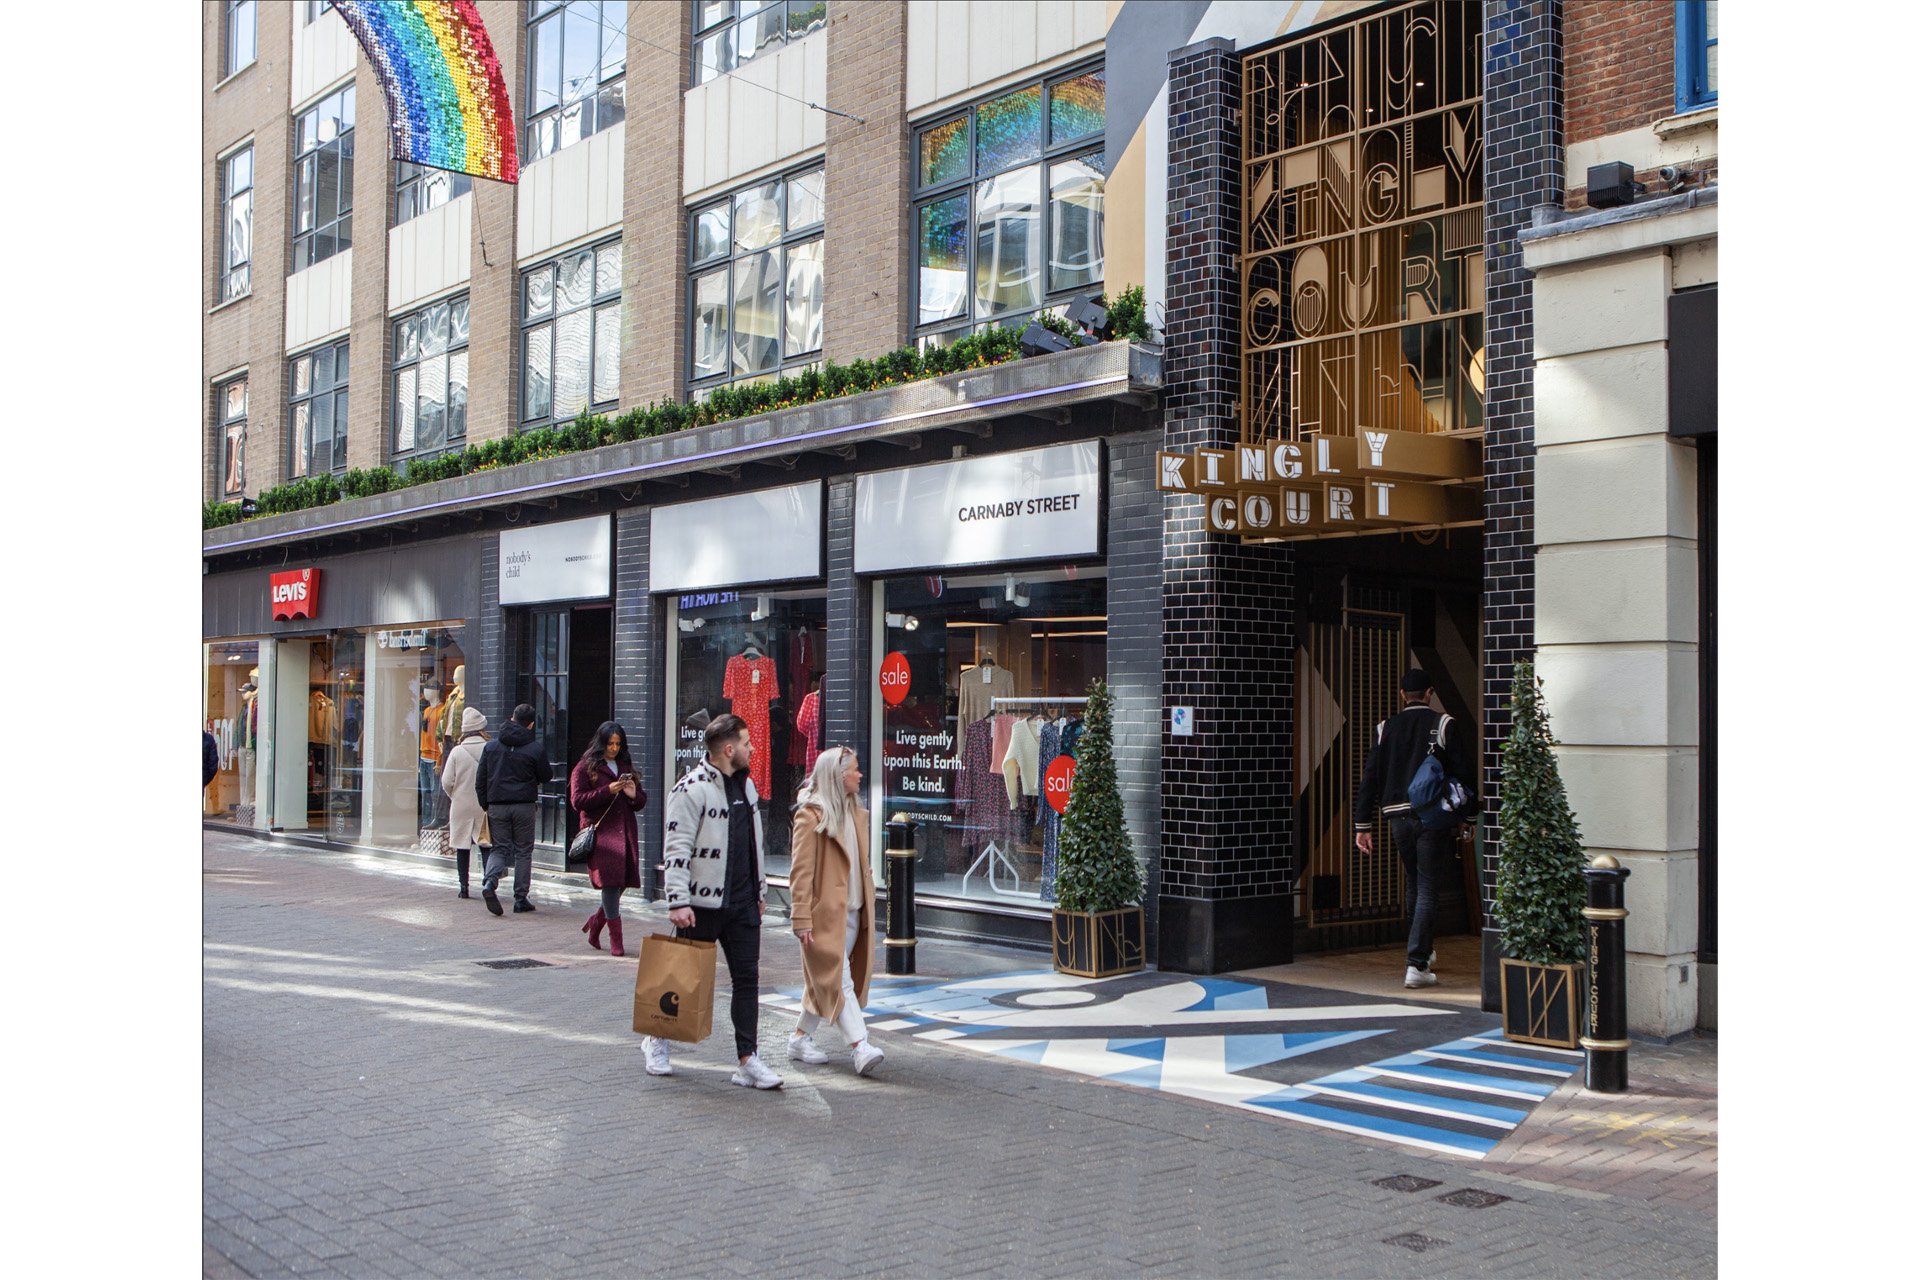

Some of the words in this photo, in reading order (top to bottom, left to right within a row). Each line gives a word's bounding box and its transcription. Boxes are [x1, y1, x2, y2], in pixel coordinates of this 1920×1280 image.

[1250, 106, 1485, 253] KINGLY
[1246, 208, 1485, 347] COURT
[1161, 431, 1389, 489] KINGLY
[958, 500, 1024, 522] CARNABY
[1026, 493, 1081, 515] STREET
[1210, 481, 1396, 531] COURT
[506, 550, 531, 566] nobody's
[505, 565, 521, 578] child
[881, 663, 909, 686] sale
[681, 725, 697, 739] Live
[896, 730, 917, 746] Live
[919, 730, 953, 750] gently
[883, 756, 910, 771] upon
[912, 753, 931, 769] this
[933, 754, 966, 770] Earth.
[902, 776, 916, 791] Be
[918, 776, 946, 793] kind.
[1590, 926, 1599, 984] KINGLY
[1590, 985, 1599, 1033] COURT
